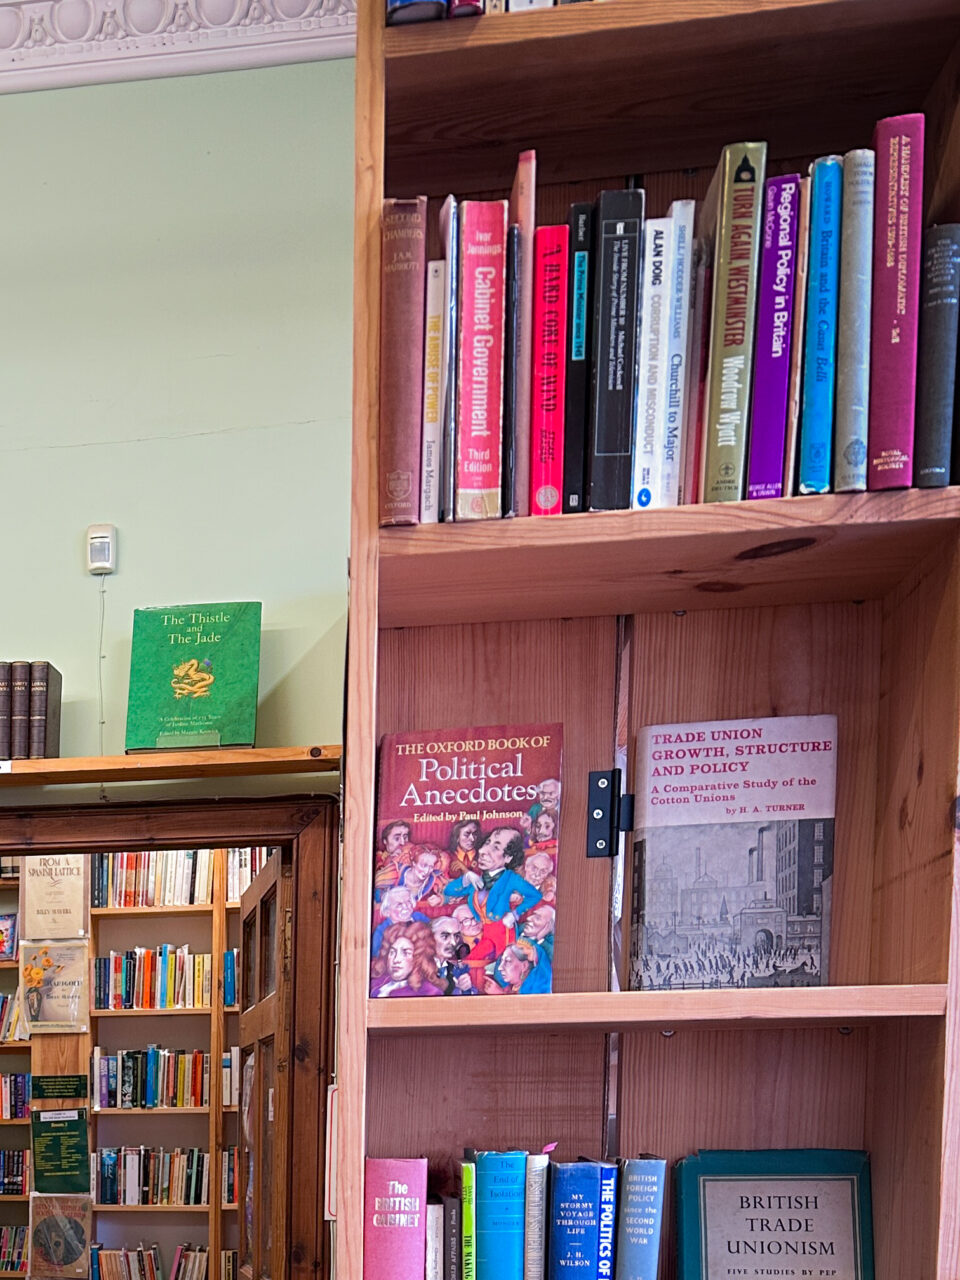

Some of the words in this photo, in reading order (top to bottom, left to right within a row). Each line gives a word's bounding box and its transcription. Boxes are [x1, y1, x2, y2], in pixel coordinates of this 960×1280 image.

[733, 186, 754, 219] TURN
[778, 183, 795, 246] Regional
[652, 228, 664, 256] ALAN
[728, 225, 752, 265] AGAIN,
[651, 258, 663, 286] DOIG
[773, 250, 791, 292] Policy
[474, 266, 495, 332] Cabinet
[723, 265, 749, 348] WESTMINSTER
[775, 296, 789, 308] in
[649, 294, 661, 361] CORRUPTION
[772, 311, 788, 357] Britain
[647, 363, 658, 385] AND
[669, 353, 683, 408] Churchill
[472, 335, 494, 438] Government
[643, 388, 657, 455] MISCONDUCT
[668, 411, 679, 423] to
[664, 426, 679, 461] Major
[162, 615, 184, 625] The
[190, 613, 230, 624] Thistle
[186, 625, 202, 633] and
[168, 634, 191, 644] The
[195, 633, 221, 645] Jade
[396, 744, 424, 755] THE
[426, 740, 485, 753] OXFORD
[488, 738, 529, 750] BOOK
[531, 736, 551, 747] OF
[652, 732, 705, 745] TRADE
[711, 728, 762, 742] UNION
[652, 747, 729, 760] GROWTH,
[735, 741, 832, 756] STRUCTURE
[418, 753, 523, 781] Political
[652, 766, 684, 776] AND
[690, 762, 749, 774] POLICY
[400, 780, 537, 807] Anecdotes
[664, 781, 739, 793] Comparative
[743, 779, 777, 789] Study
[782, 778, 794, 786] of
[798, 777, 816, 786] the
[651, 795, 690, 805] Cotton
[694, 793, 736, 802] Unions
[414, 812, 444, 822] Edited
[446, 812, 458, 822] by
[459, 811, 480, 821] Paul
[482, 810, 522, 819] Johnson
[602, 1178, 614, 1201] THE
[560, 1210, 593, 1218] VOYAGE
[740, 1196, 819, 1210] BRITISH
[600, 1203, 613, 1257] POLITICS
[745, 1218, 814, 1232] TRADE
[727, 1241, 835, 1255] UNIONISM
[559, 1259, 590, 1267] WILSON
[598, 1259, 610, 1277] OF
